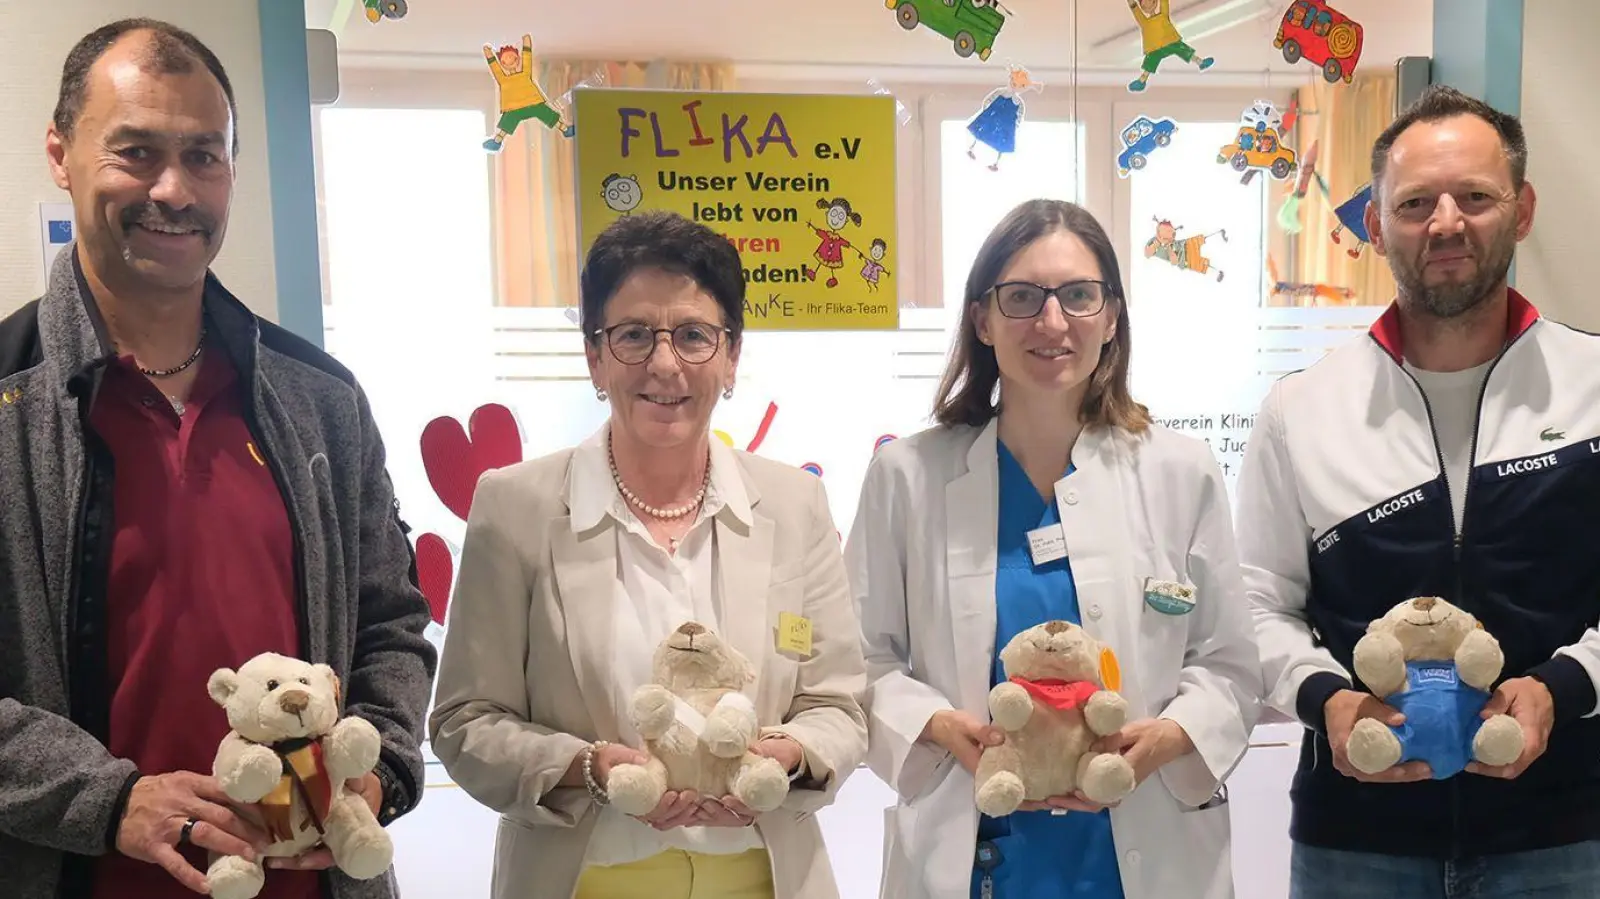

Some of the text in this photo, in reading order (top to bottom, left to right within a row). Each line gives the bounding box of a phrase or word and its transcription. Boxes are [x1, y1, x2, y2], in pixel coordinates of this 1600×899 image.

[617, 99, 861, 163] FLIKA e.V
[657, 171, 830, 192] Unser Verein
[693, 202, 798, 222] lebt von
[806, 302, 822, 314] Ihr
[825, 302, 888, 315] Flika-Team
[1221, 413, 1257, 429] Klini
[1497, 453, 1558, 477] LACOSTE
[1367, 489, 1425, 523] LACOSTE
